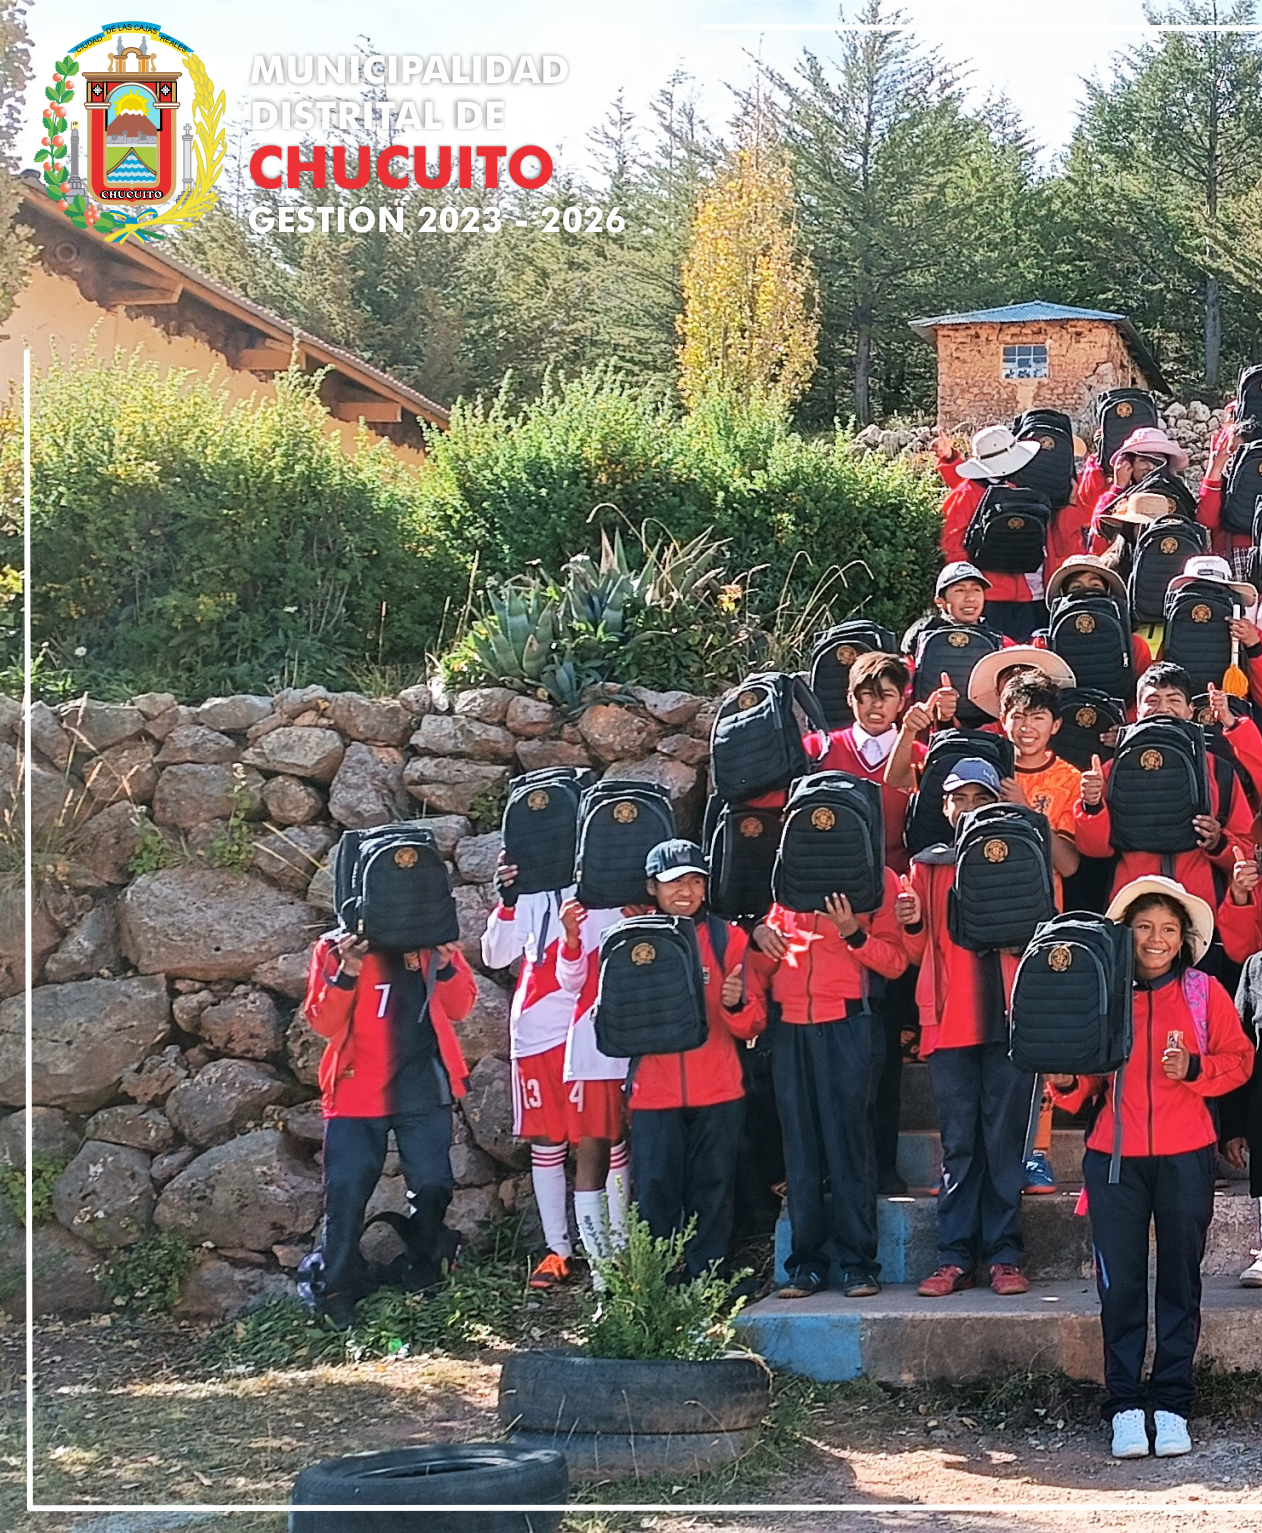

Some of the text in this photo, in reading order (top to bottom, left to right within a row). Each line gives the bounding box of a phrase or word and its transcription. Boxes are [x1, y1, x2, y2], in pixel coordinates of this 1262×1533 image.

[374, 984, 391, 1018] 7
[520, 1078, 542, 1110] 13
[568, 1080, 584, 1113] 4
